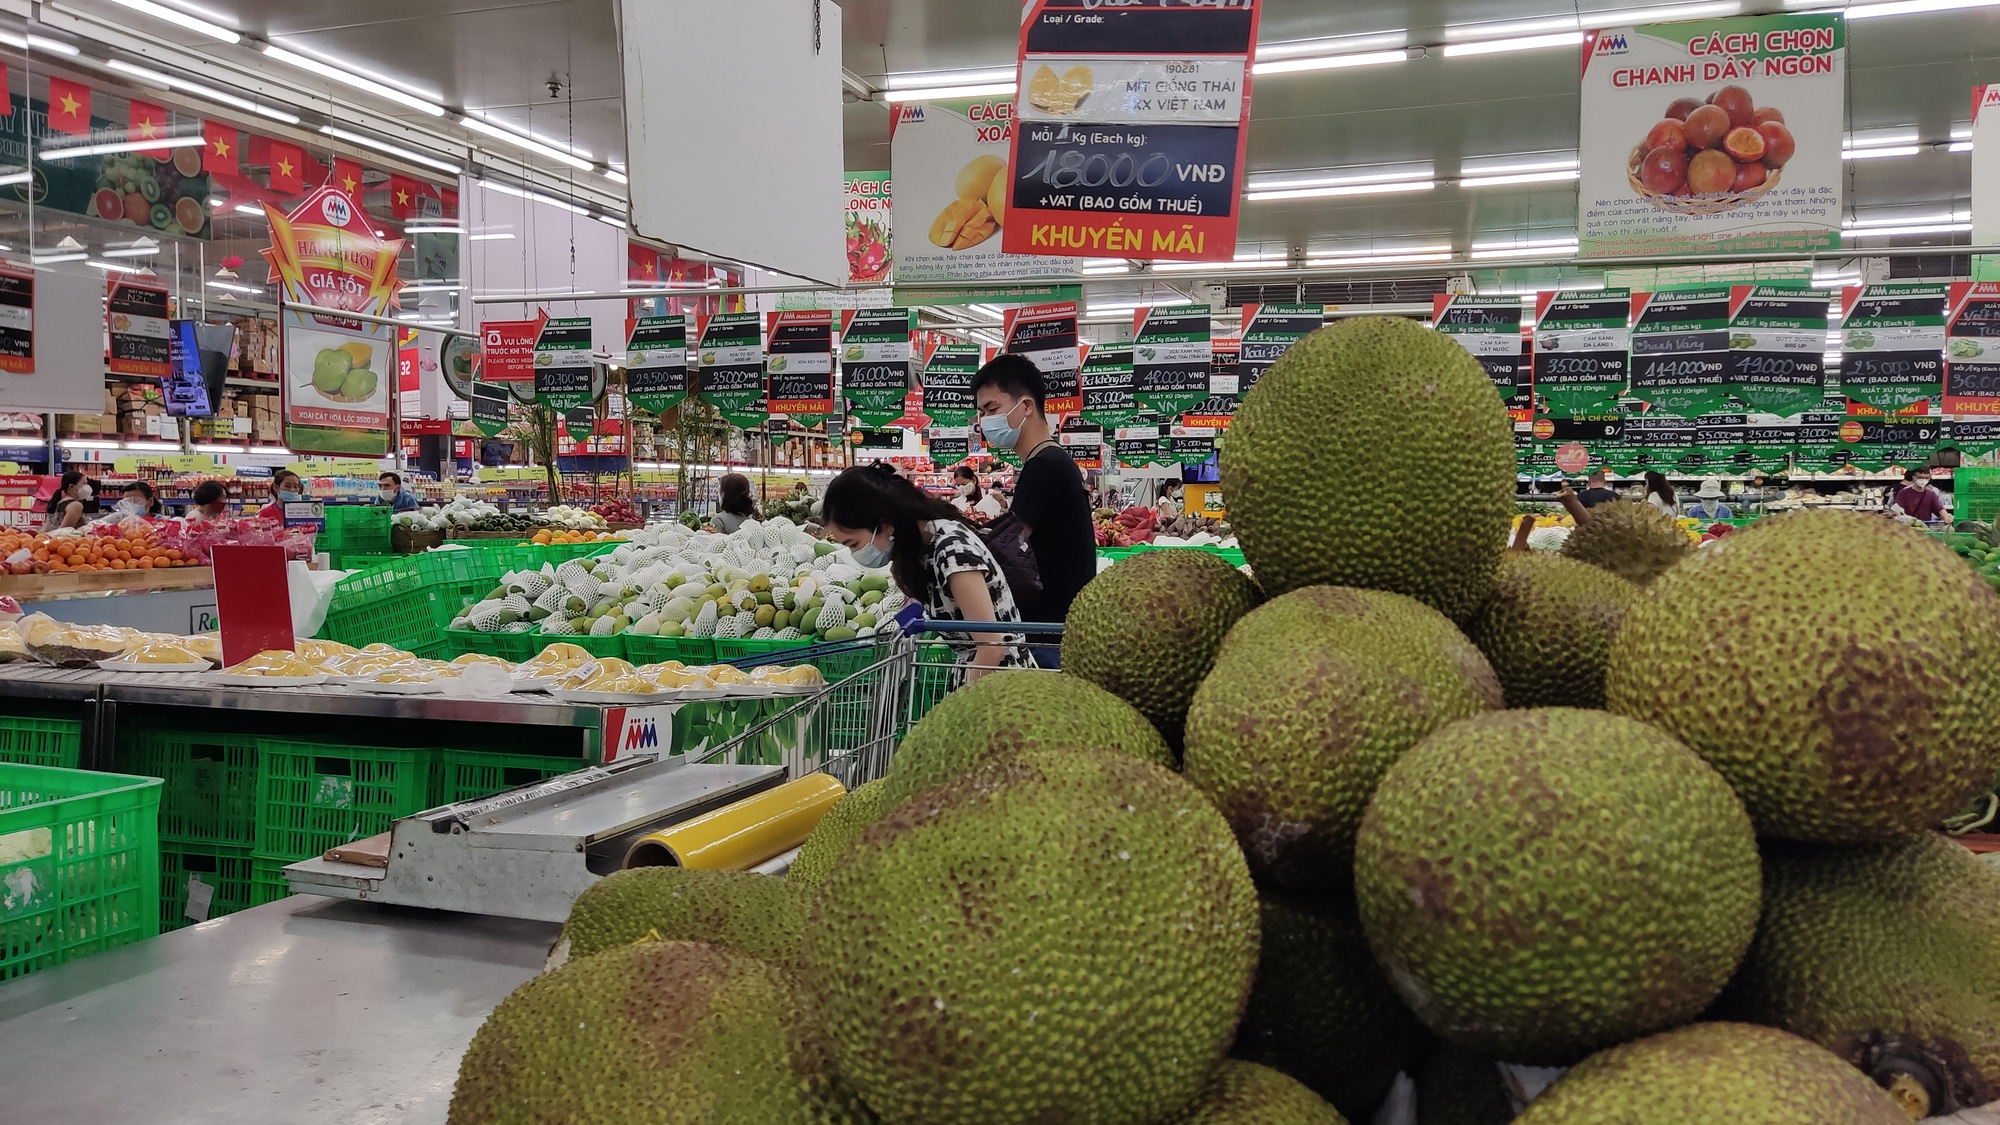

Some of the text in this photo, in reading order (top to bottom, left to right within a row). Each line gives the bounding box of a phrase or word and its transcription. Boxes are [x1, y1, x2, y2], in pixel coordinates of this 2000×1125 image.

[1044, 15, 1063, 25] Loại
[1074, 15, 1104, 24] Grade:
[1689, 29, 1832, 56] CÁCH CHỌN
[1165, 65, 1199, 74] 190281
[1613, 55, 1832, 87] CHANH DÂY NGON
[1126, 79, 1150, 93] MÍT
[1203, 78, 1235, 92] THÁI
[1158, 98, 1189, 112] VIỆT
[1032, 126, 1053, 142] MỖI
[1073, 133, 1086, 146] Kg
[1090, 133, 1123, 145] (Each
[1127, 133, 1148, 147] kg):
[1176, 163, 1225, 183] VNĐ
[1040, 192, 1202, 214] +VAT (BAO GỒM THUẾ)
[1032, 217, 1204, 253] KHUYẾN MÃI
[310, 271, 365, 297] GIÁ TỐT
[516, 337, 533, 345] LÒNG
[119, 362, 150, 373] KHUYẾN
[400, 360, 410, 376] 32
[1601, 361, 1622, 369] VNĐ
[1701, 363, 1722, 371] VNĐ
[1796, 363, 1818, 371] VNĐ
[1914, 361, 1936, 369] VNĐ
[776, 401, 825, 411] KHUYẾN MÃI
[1057, 400, 1074, 410] MÃI
[1157, 400, 1178, 413] VN
[1191, 417, 1221, 426] KHUYẾN
